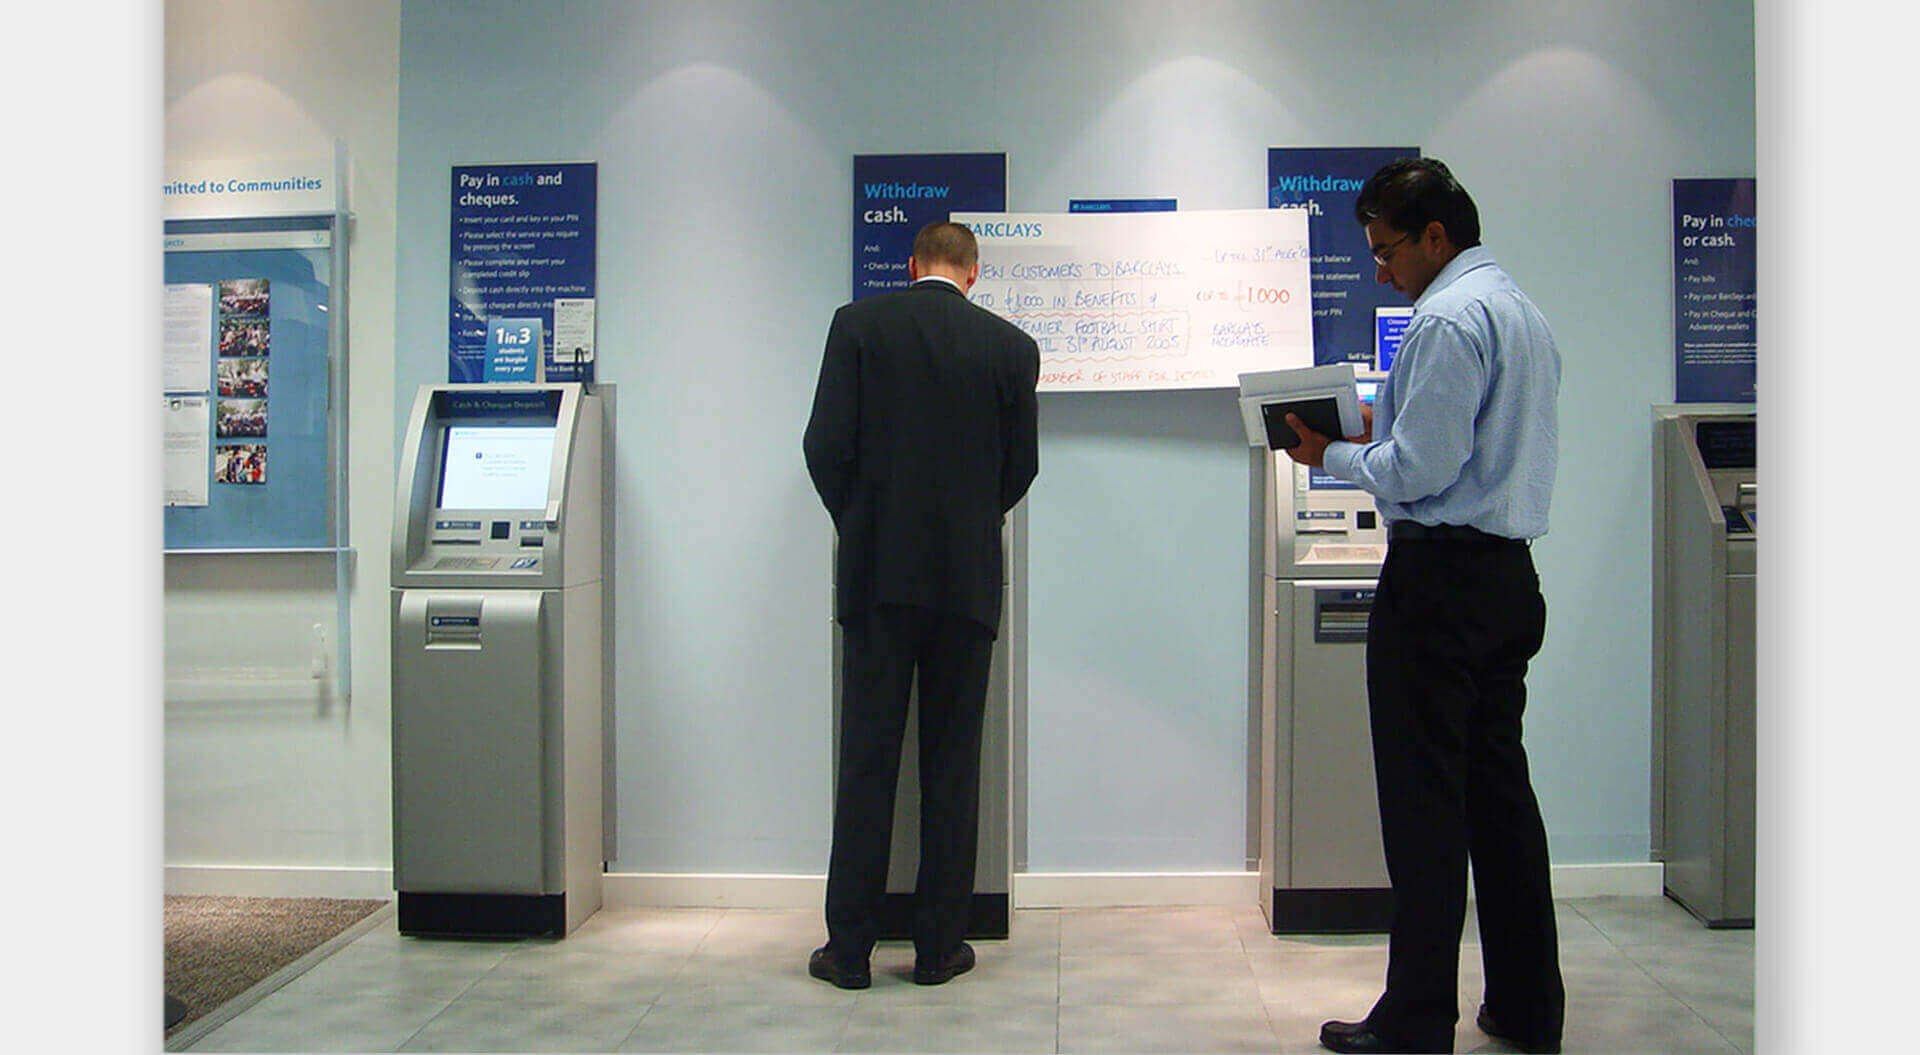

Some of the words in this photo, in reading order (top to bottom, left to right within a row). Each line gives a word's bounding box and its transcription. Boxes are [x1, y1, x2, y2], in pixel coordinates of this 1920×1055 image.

[210, 181, 224, 193] to
[227, 176, 322, 192] Communities
[460, 174, 484, 189] Pay
[487, 173, 499, 186] in
[502, 172, 533, 186] cash
[536, 171, 562, 185] and
[1279, 175, 1365, 192] Withdraw
[864, 183, 950, 199] Withdraw
[459, 193, 519, 208] cheques.
[530, 214, 541, 223] key
[863, 206, 908, 223] cash.
[1683, 214, 1707, 230] Pay
[1710, 214, 1724, 227] in
[486, 231, 505, 239] select
[543, 231, 554, 239] you
[1683, 236, 1699, 247] or
[1701, 233, 1736, 247] cash.
[550, 258, 565, 267] your
[1324, 254, 1351, 263] balance
[868, 262, 890, 270] Check
[891, 263, 906, 271] your
[1326, 273, 1360, 281] statement
[1688, 275, 1700, 283] Pay
[868, 279, 884, 287] Print
[1689, 293, 1700, 302] Pay
[1329, 308, 1342, 316] PIN
[1689, 310, 1700, 319] Pay
[1710, 310, 1735, 319] Cheque
[1689, 323, 1725, 332] Advantage
[505, 331, 517, 344] in
